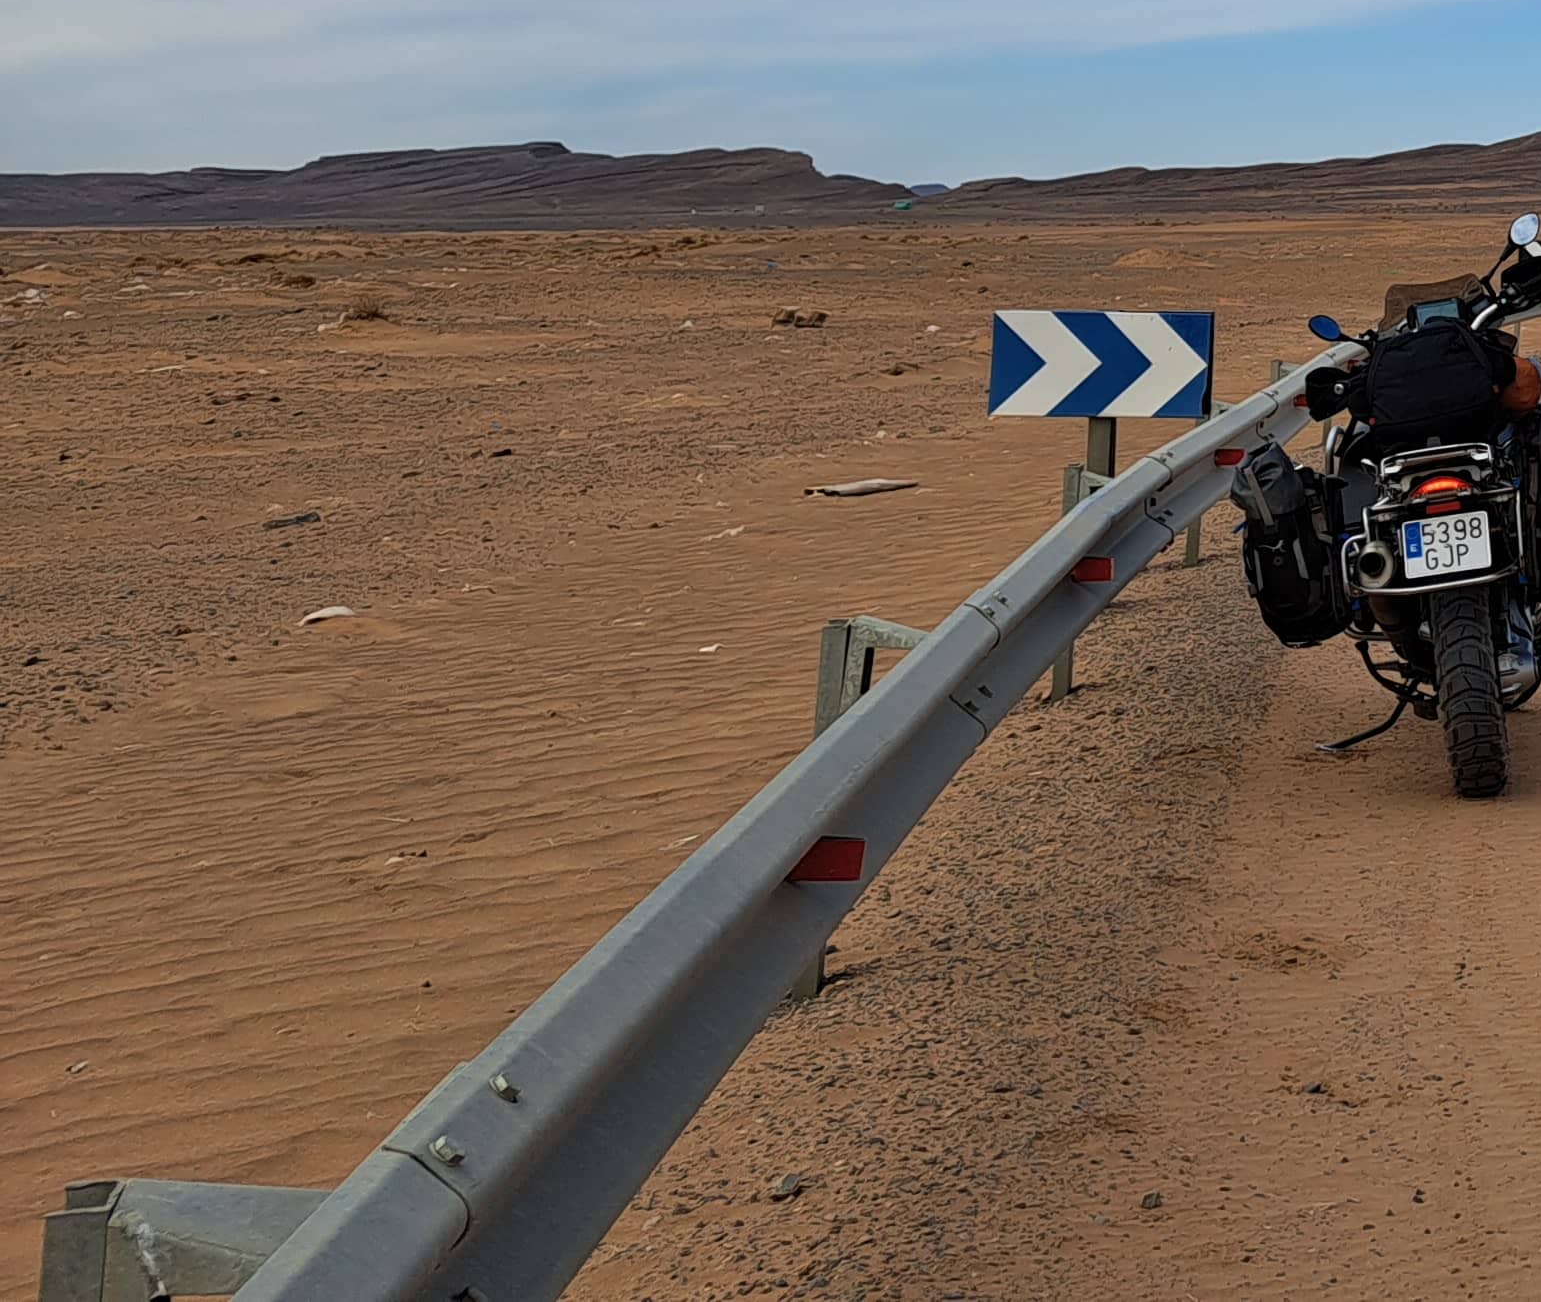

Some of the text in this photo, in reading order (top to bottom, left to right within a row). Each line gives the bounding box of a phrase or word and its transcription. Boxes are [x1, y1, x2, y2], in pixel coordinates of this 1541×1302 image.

[1422, 517, 1482, 545] 5398
[1410, 544, 1418, 553] E
[1425, 543, 1469, 570] GJP
